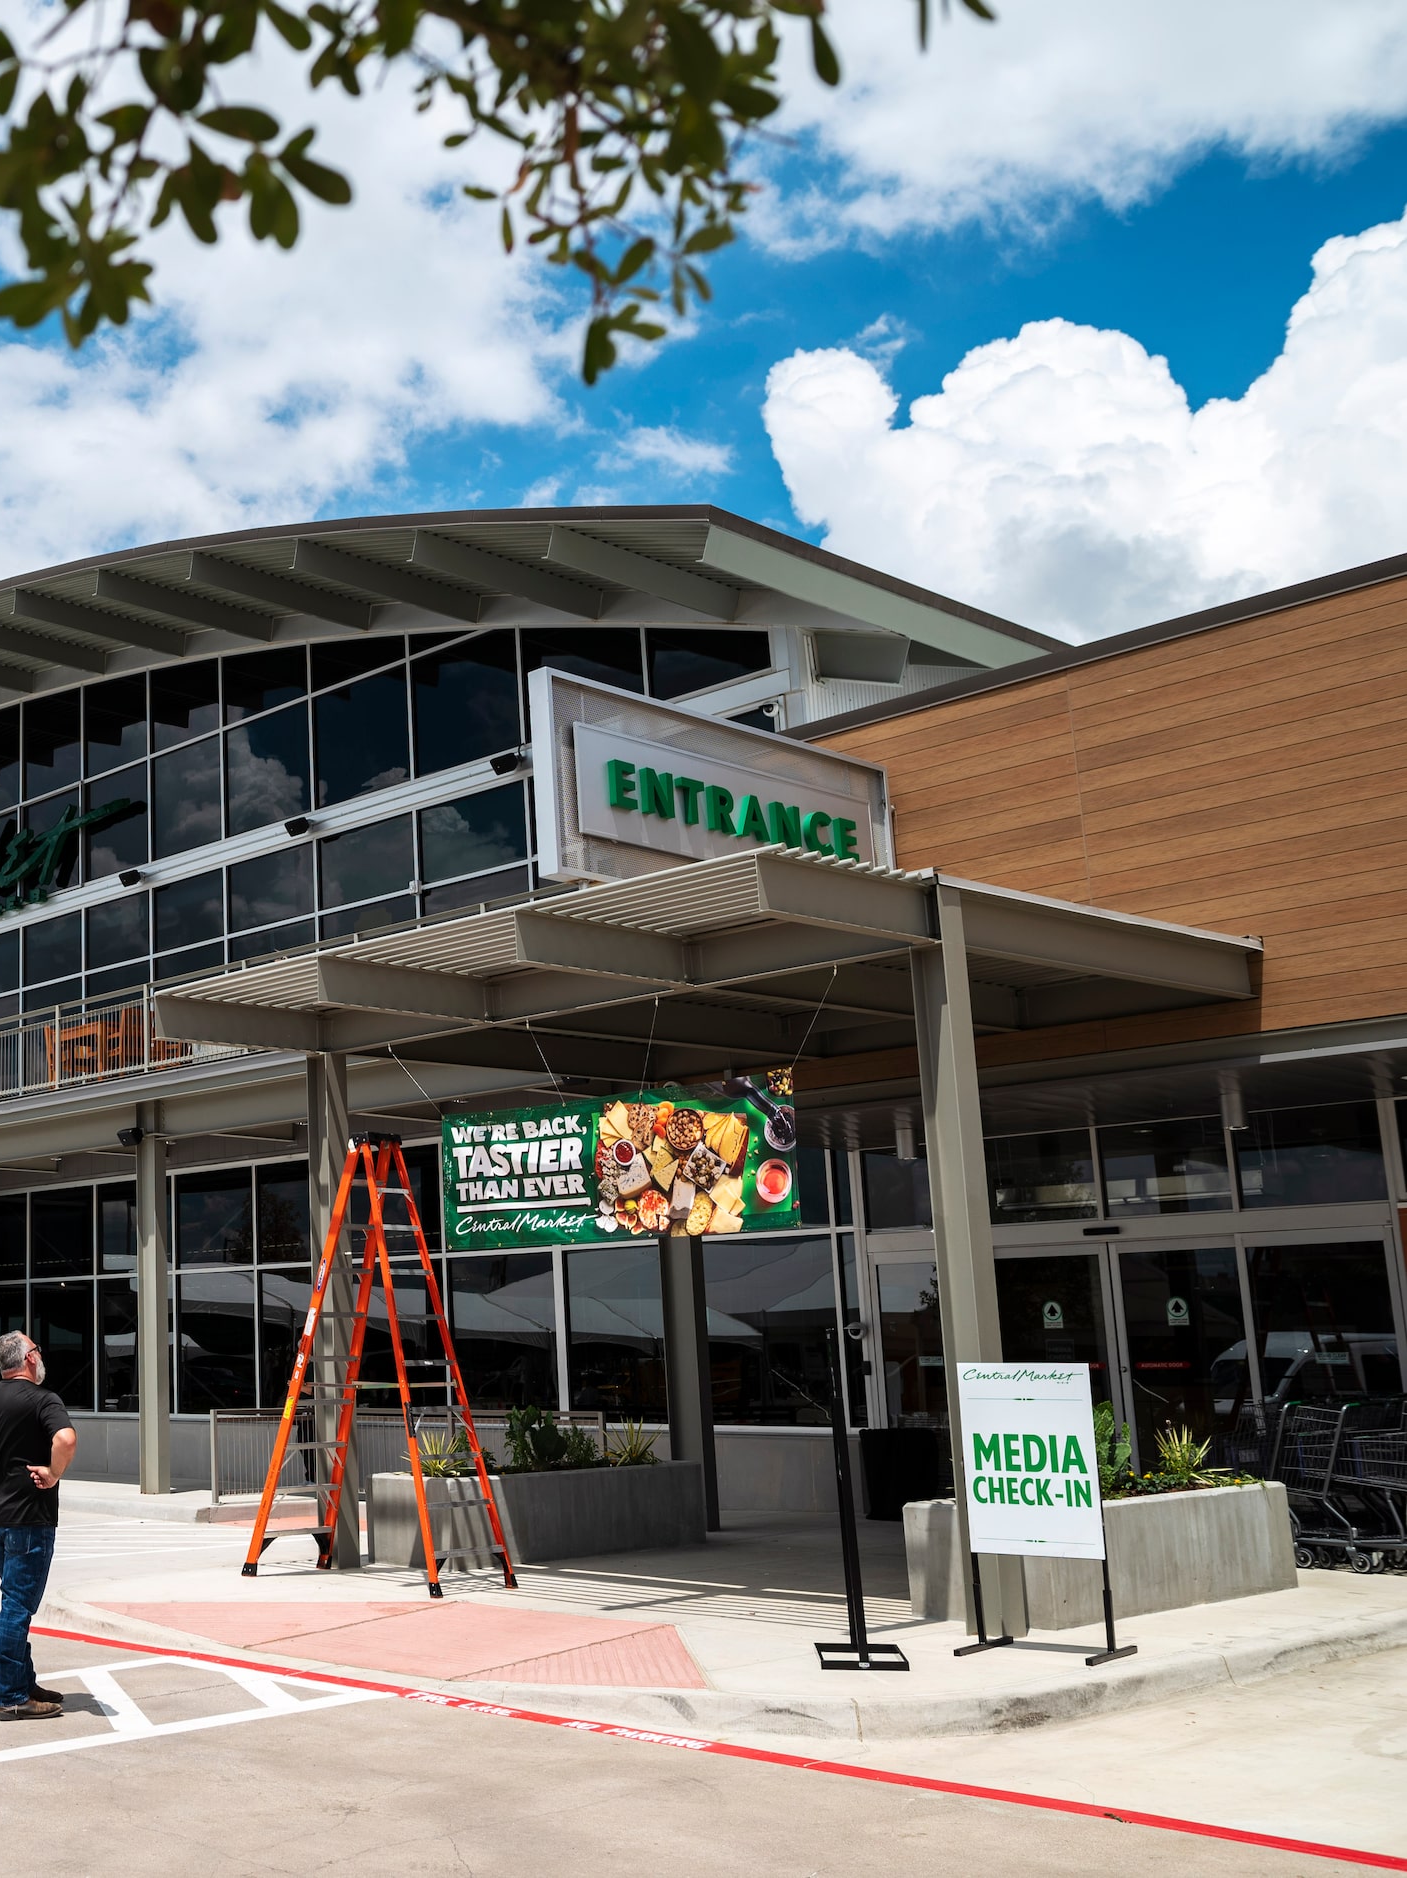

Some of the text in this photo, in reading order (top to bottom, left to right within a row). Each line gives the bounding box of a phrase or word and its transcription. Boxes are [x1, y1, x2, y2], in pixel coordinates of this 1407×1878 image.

[607, 758, 860, 862] ENTRANCE
[451, 1114, 587, 1144] WE'RE BACK,
[452, 1136, 583, 1179] TASTIER
[456, 1174, 587, 1202] THAN EVER
[455, 1211, 599, 1236] Central Market
[962, 1369, 1084, 1382] Central Market
[972, 1433, 1088, 1474] MEDIA
[972, 1476, 1093, 1508] CHECK-IN
[404, 1691, 713, 1750] FIRE LANE NO PARKING
